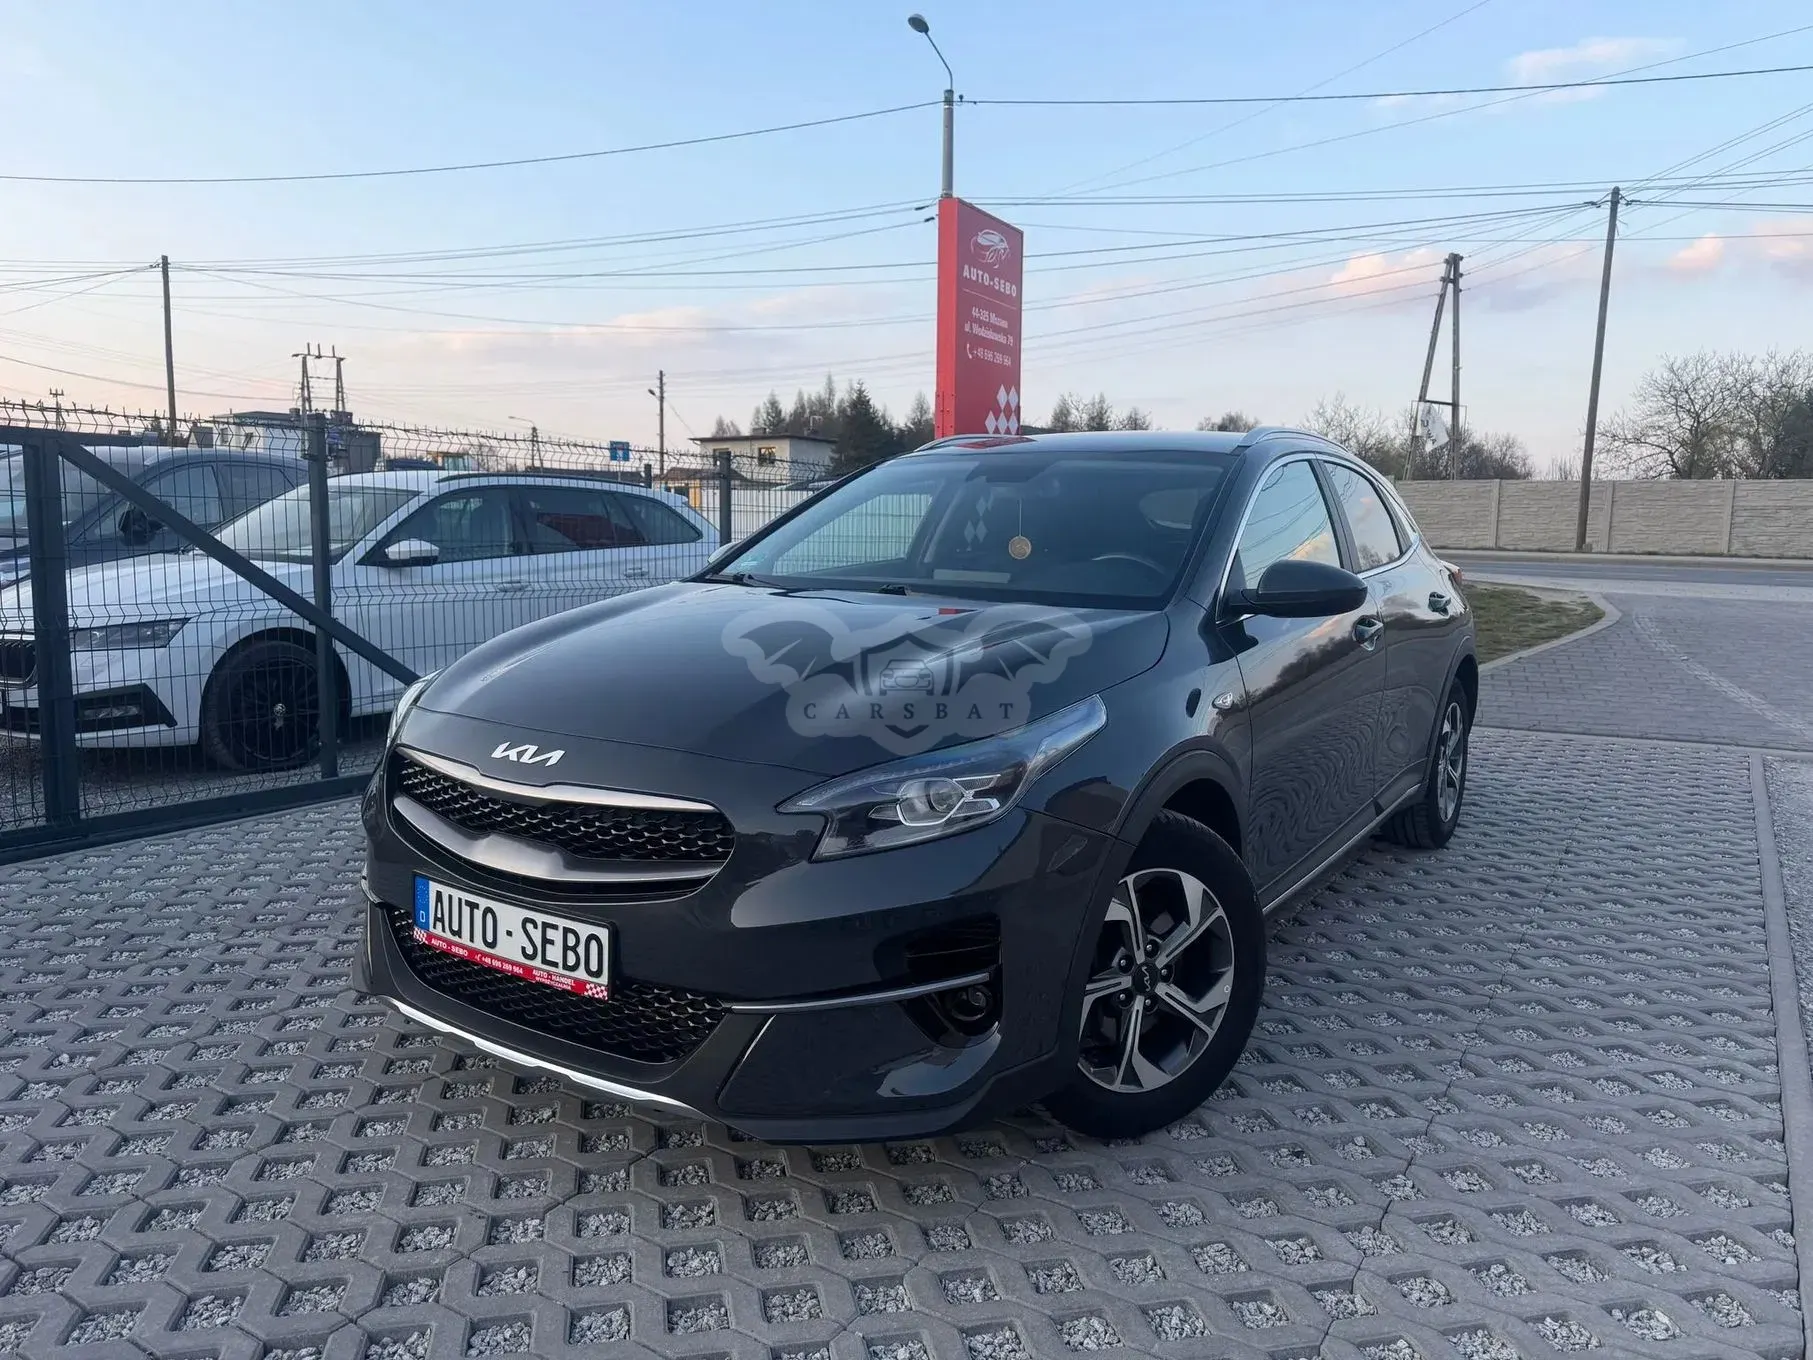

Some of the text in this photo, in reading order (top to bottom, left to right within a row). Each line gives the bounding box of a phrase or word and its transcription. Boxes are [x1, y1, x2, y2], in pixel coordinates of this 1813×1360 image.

[963, 264, 1017, 297] AUTO-SEBO
[419, 910, 426, 923] D
[433, 890, 498, 949] AUTO
[521, 916, 604, 979] SEBO
[431, 938, 447, 949] AUTO
[451, 945, 468, 957] SEBO
[532, 969, 548, 979] AUTO
[552, 974, 576, 986] HANDEL
